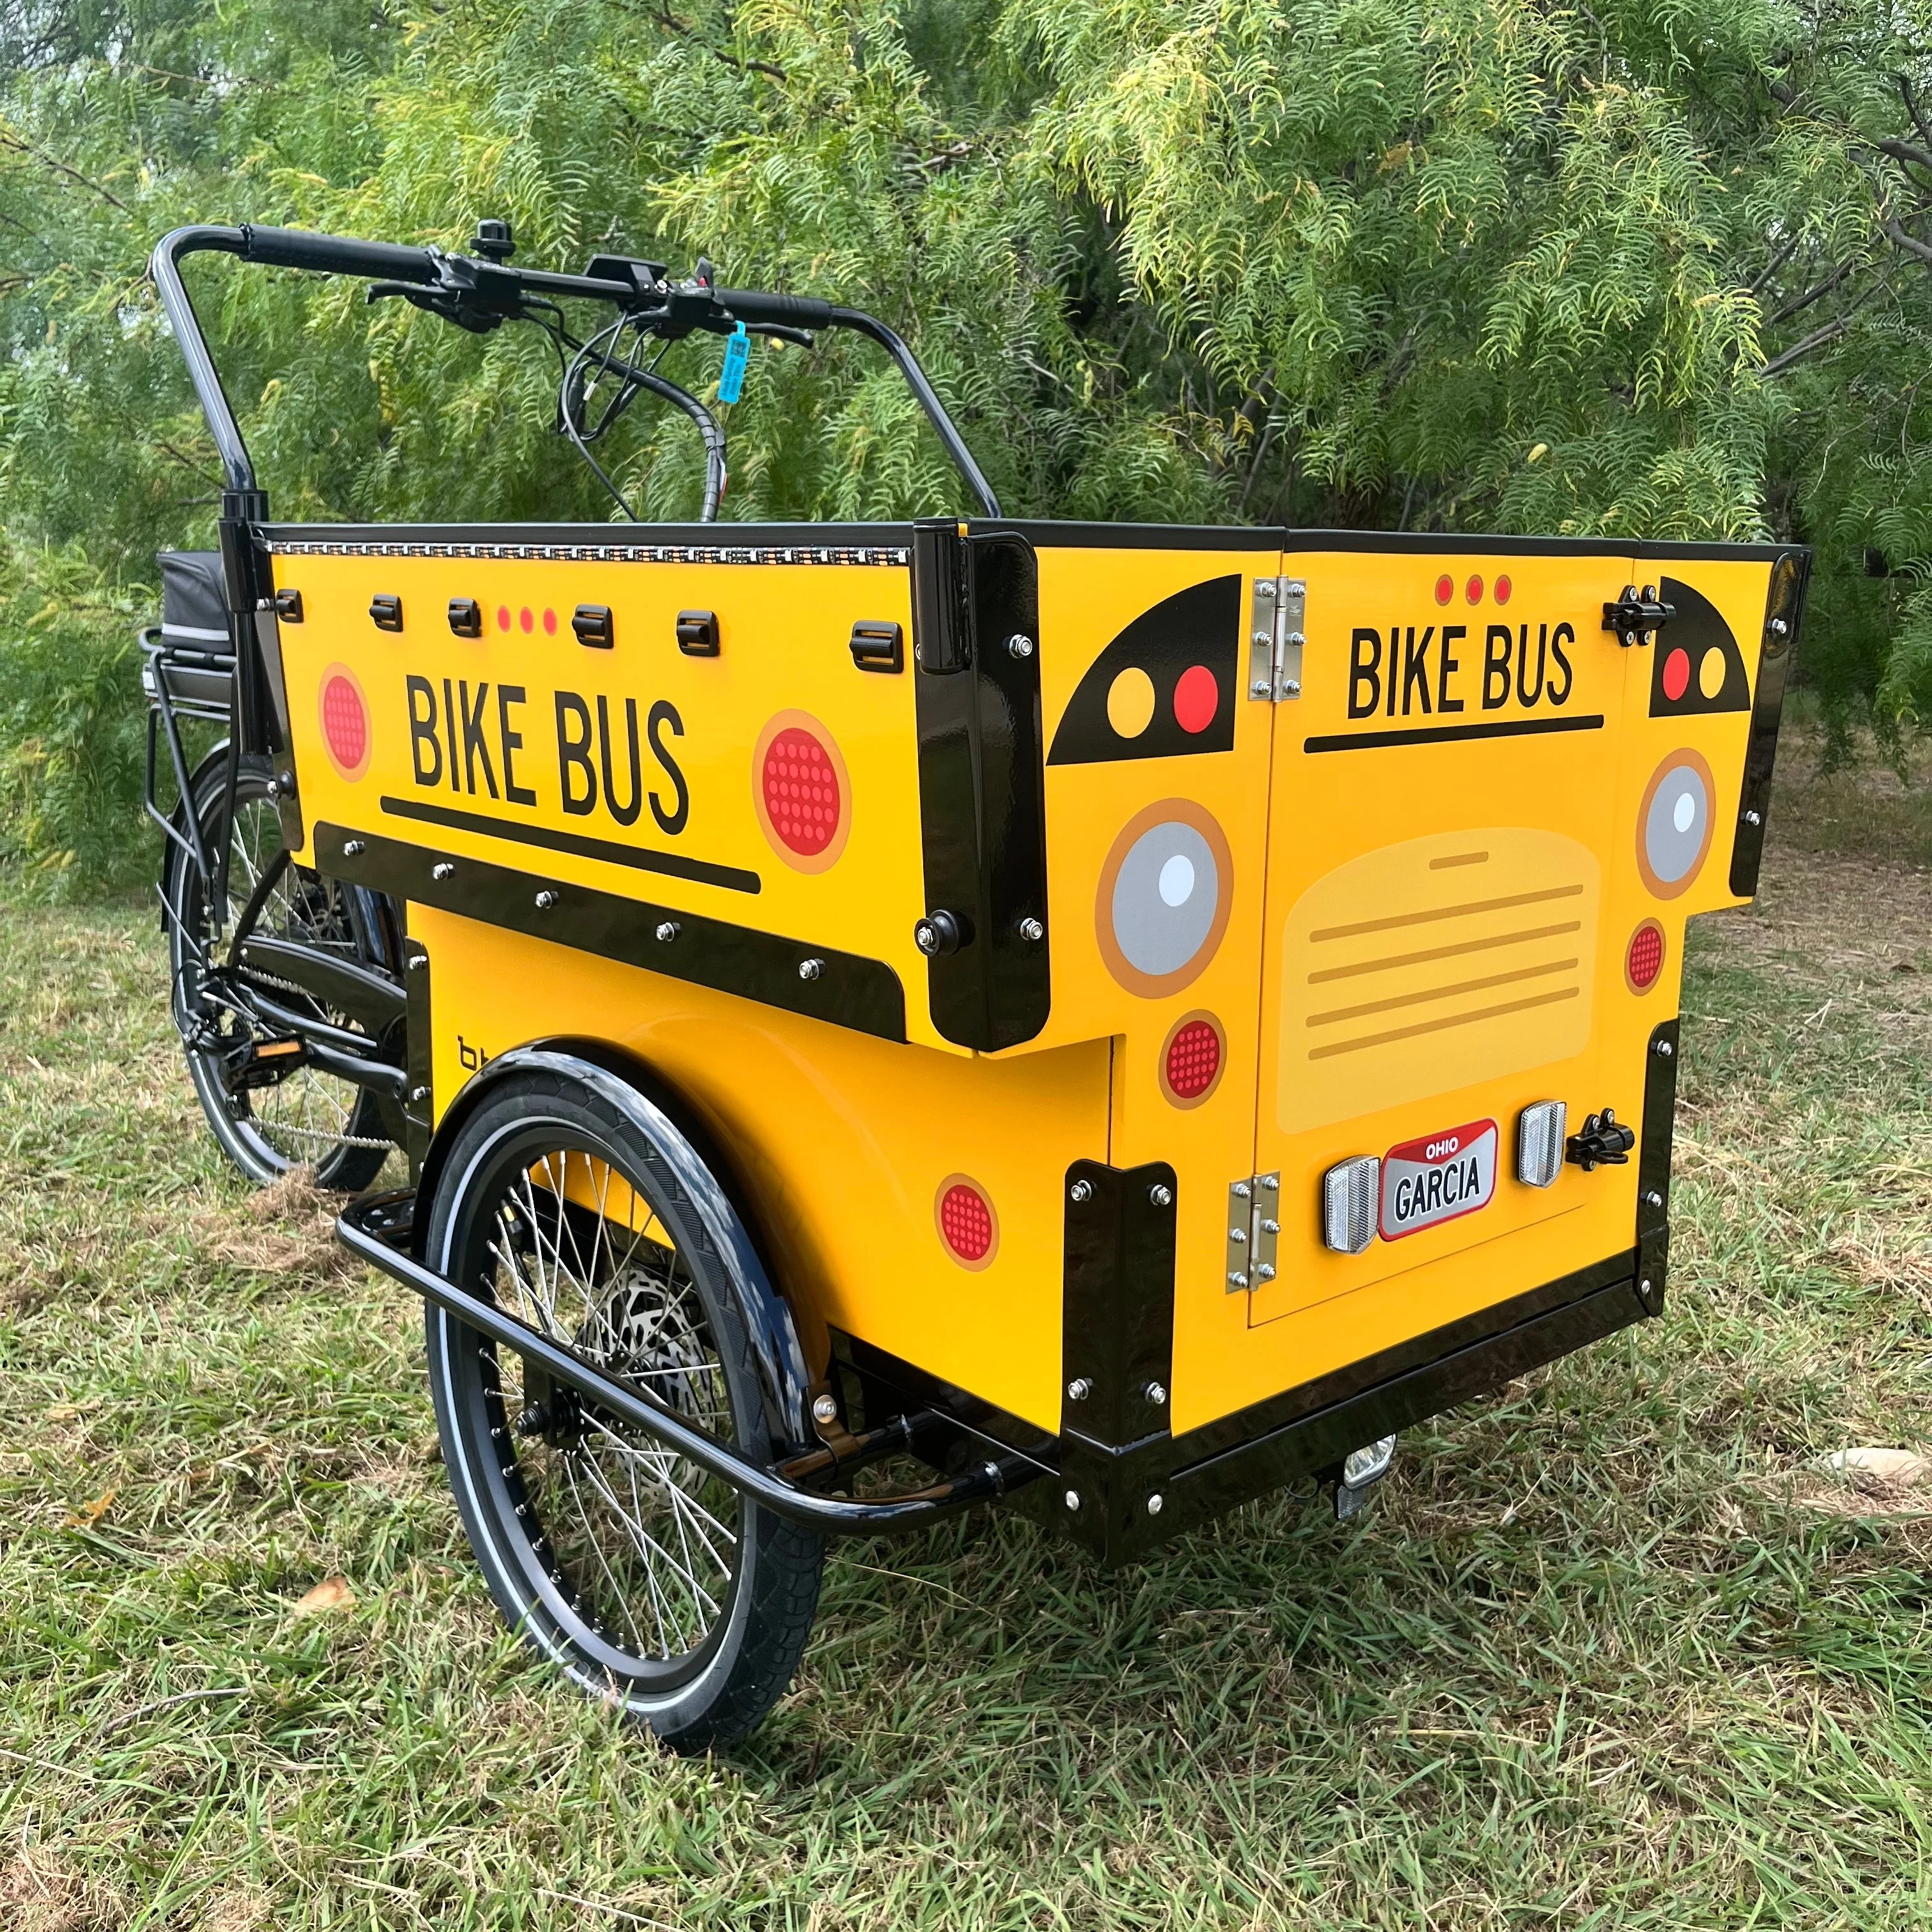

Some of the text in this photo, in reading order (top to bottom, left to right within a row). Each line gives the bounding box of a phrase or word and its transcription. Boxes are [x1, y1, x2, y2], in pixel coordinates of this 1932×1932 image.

[1348, 622, 1575, 719] BIKE BUS
[406, 675, 689, 835] BIKE BUS
[1395, 1156, 1480, 1221] GARCIA
[1426, 1137, 1458, 1160] OHIO
